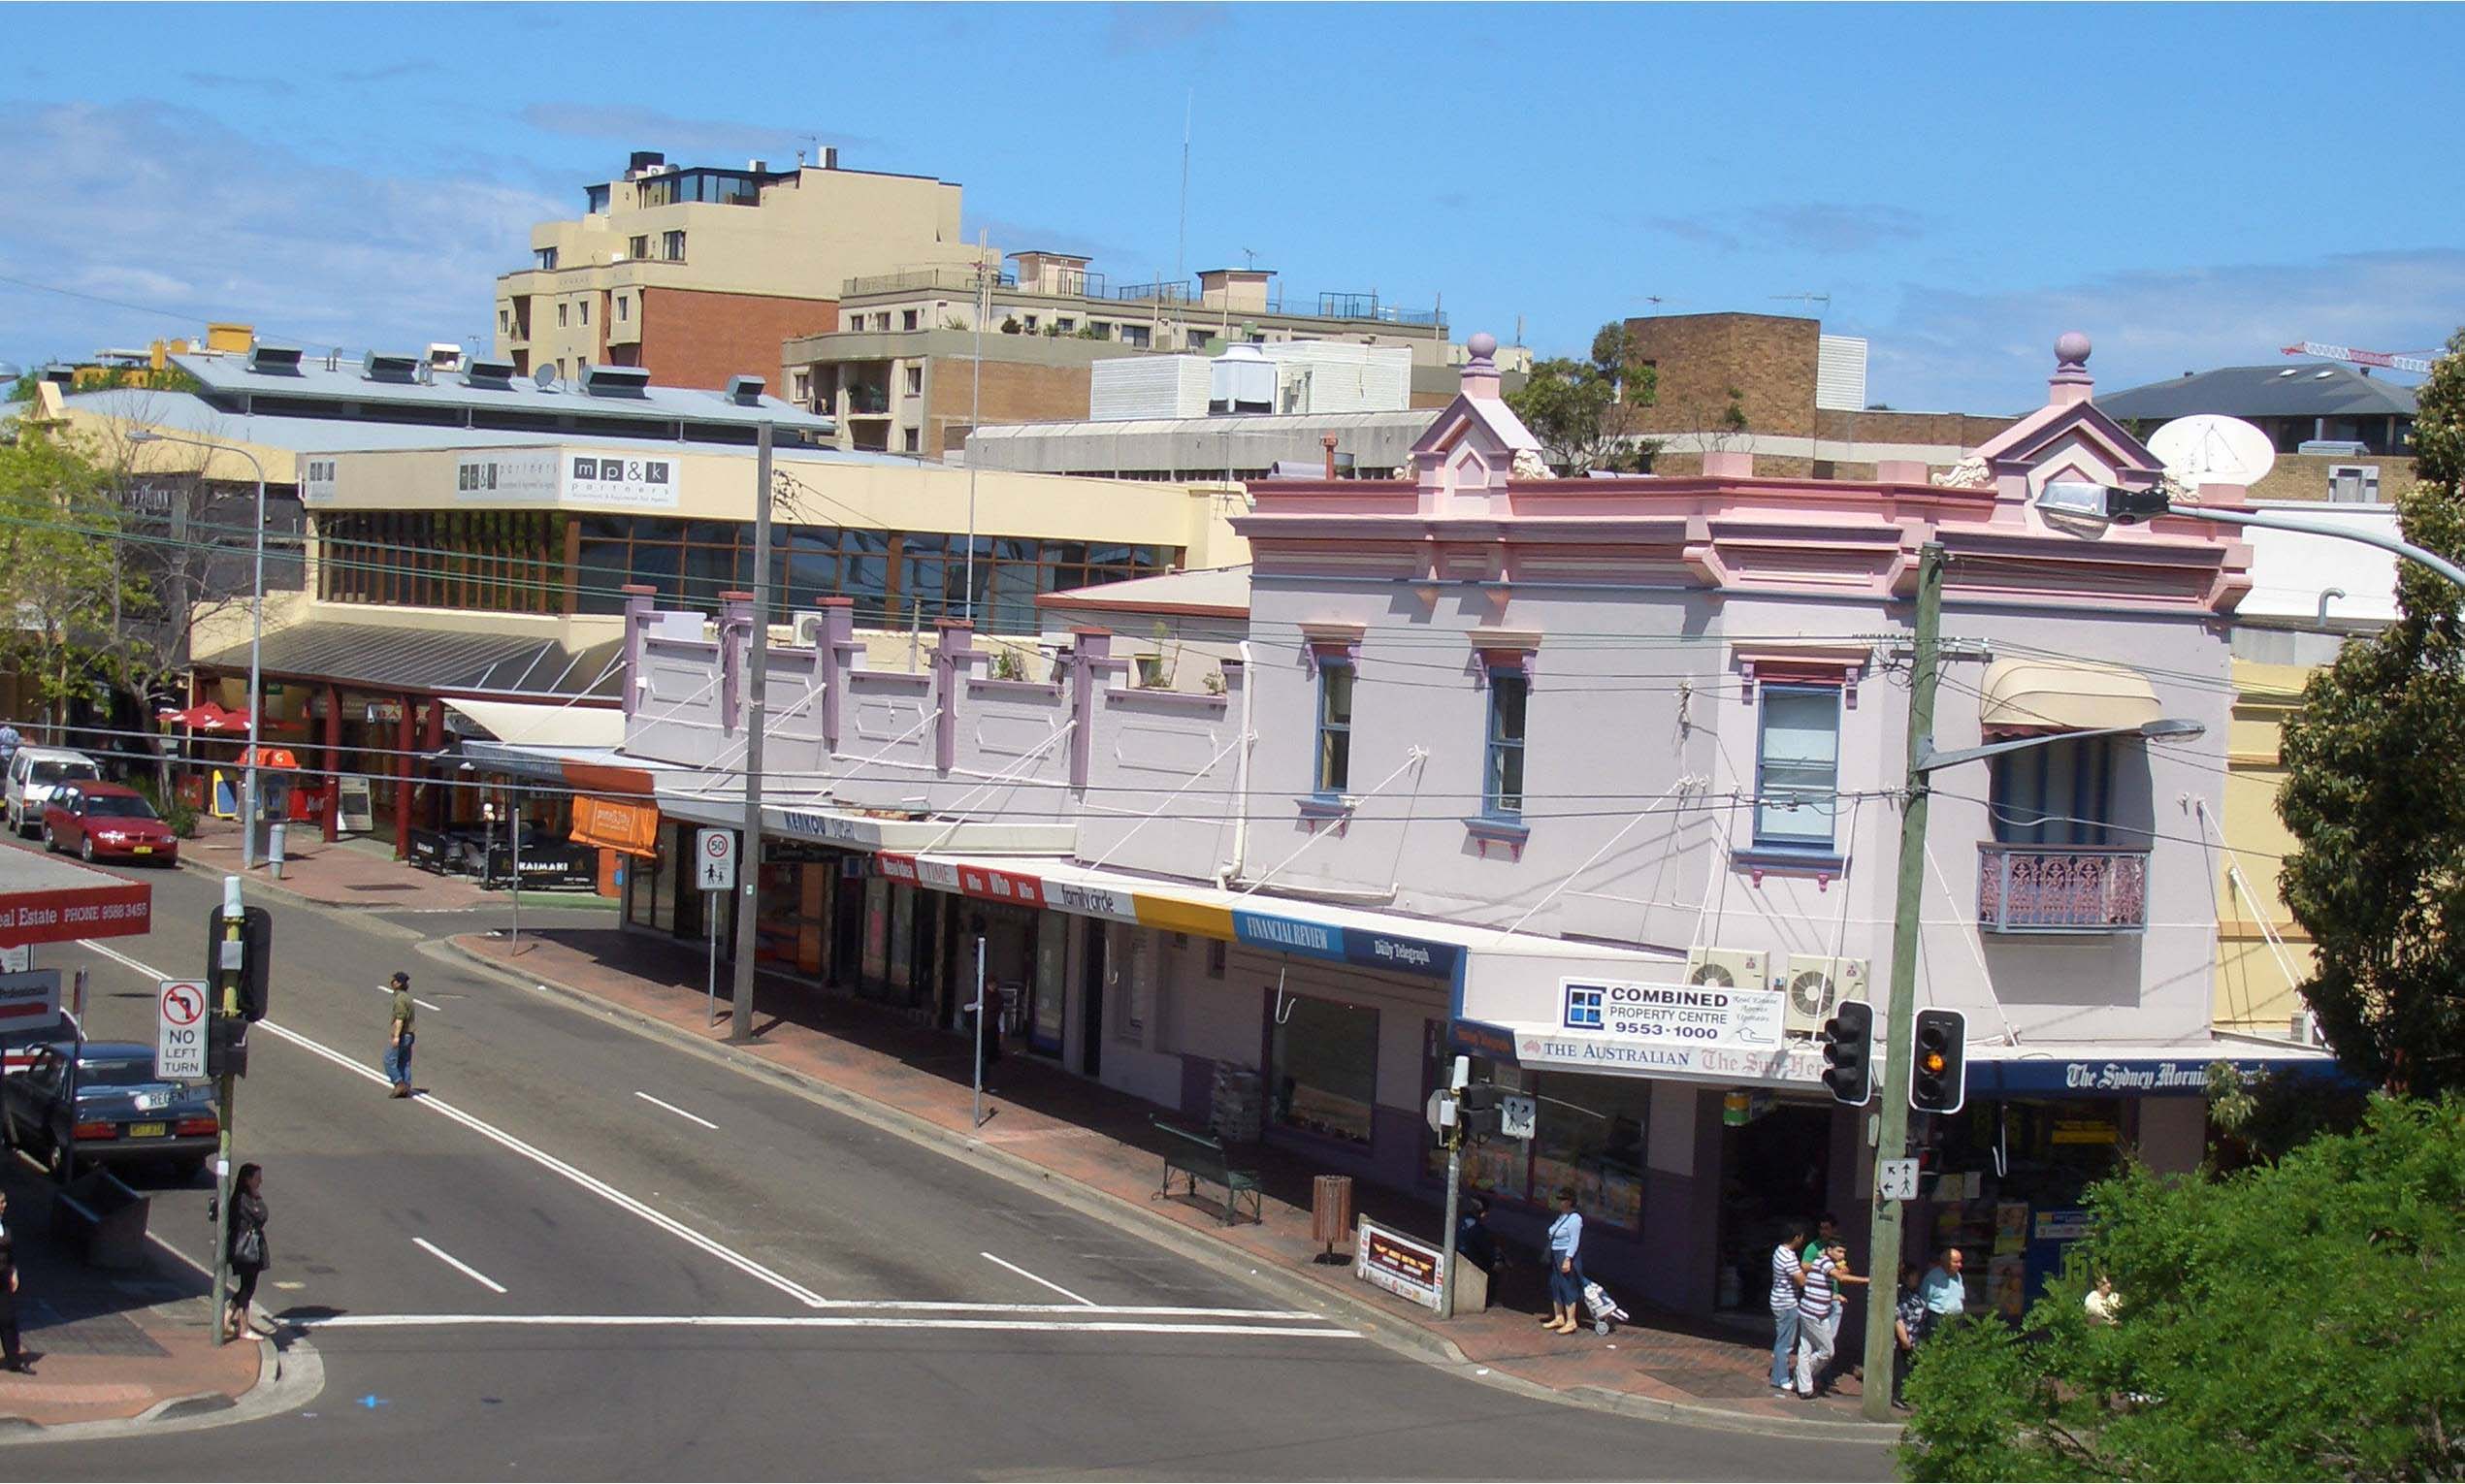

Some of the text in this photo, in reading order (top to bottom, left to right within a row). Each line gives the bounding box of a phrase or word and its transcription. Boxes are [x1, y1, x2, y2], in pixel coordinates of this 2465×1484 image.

[711, 840, 725, 851] 50
[18, 908, 58, 926] Estate
[64, 907, 99, 922] PHONE
[1247, 915, 1328, 950] FINANCIAL REVIEW
[1374, 939, 1431, 965] Daily Telegraph
[1610, 987, 1729, 1008] COMBINED
[1609, 1006, 1728, 1025] PROPERTY CENTRE
[169, 1029, 195, 1045] NO
[165, 1048, 197, 1058] LEFT
[1544, 1043, 1576, 1057] THE
[164, 1062, 199, 1073] TURN
[1702, 1048, 1738, 1072] The
[2066, 1063, 2096, 1087] The
[2096, 1063, 2155, 1089] Sydney
[150, 1092, 190, 1106] REGENT
